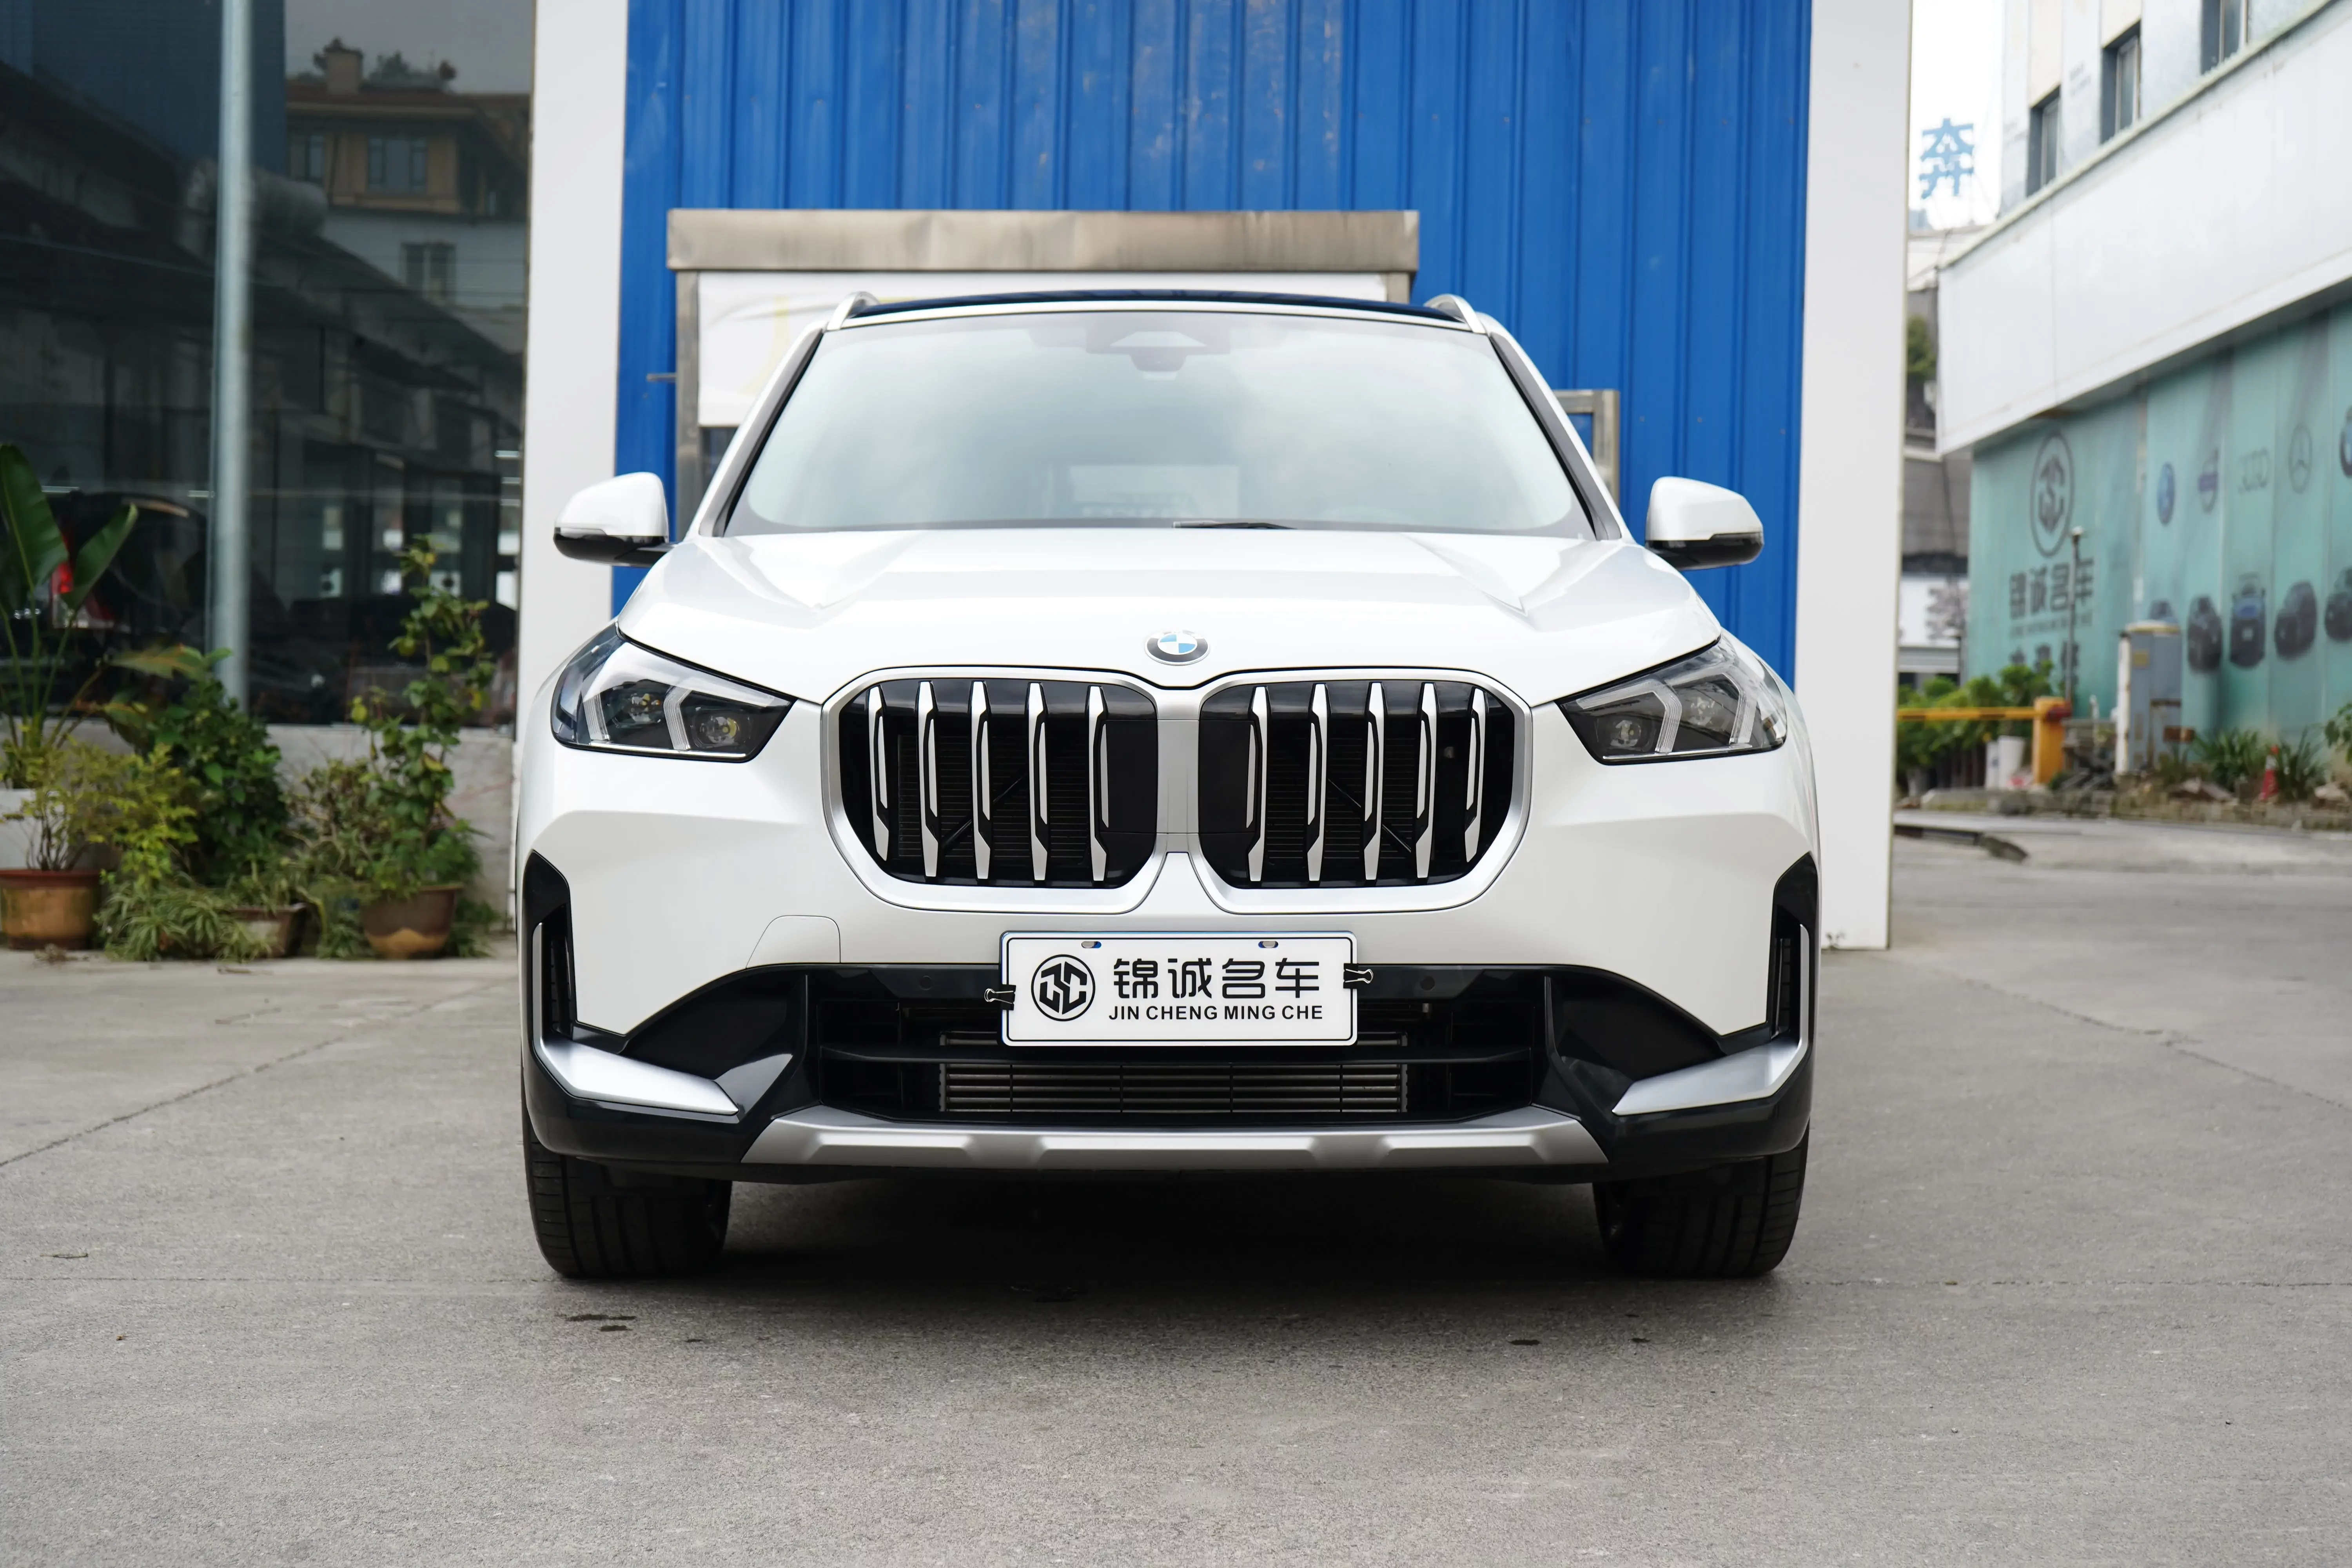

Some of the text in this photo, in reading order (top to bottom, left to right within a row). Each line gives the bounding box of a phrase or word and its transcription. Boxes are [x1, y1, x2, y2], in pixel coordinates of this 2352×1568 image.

[1113, 958, 1320, 999] 锦诚名车
[1109, 1005, 1323, 1020] JIN CHENG MING CHE
